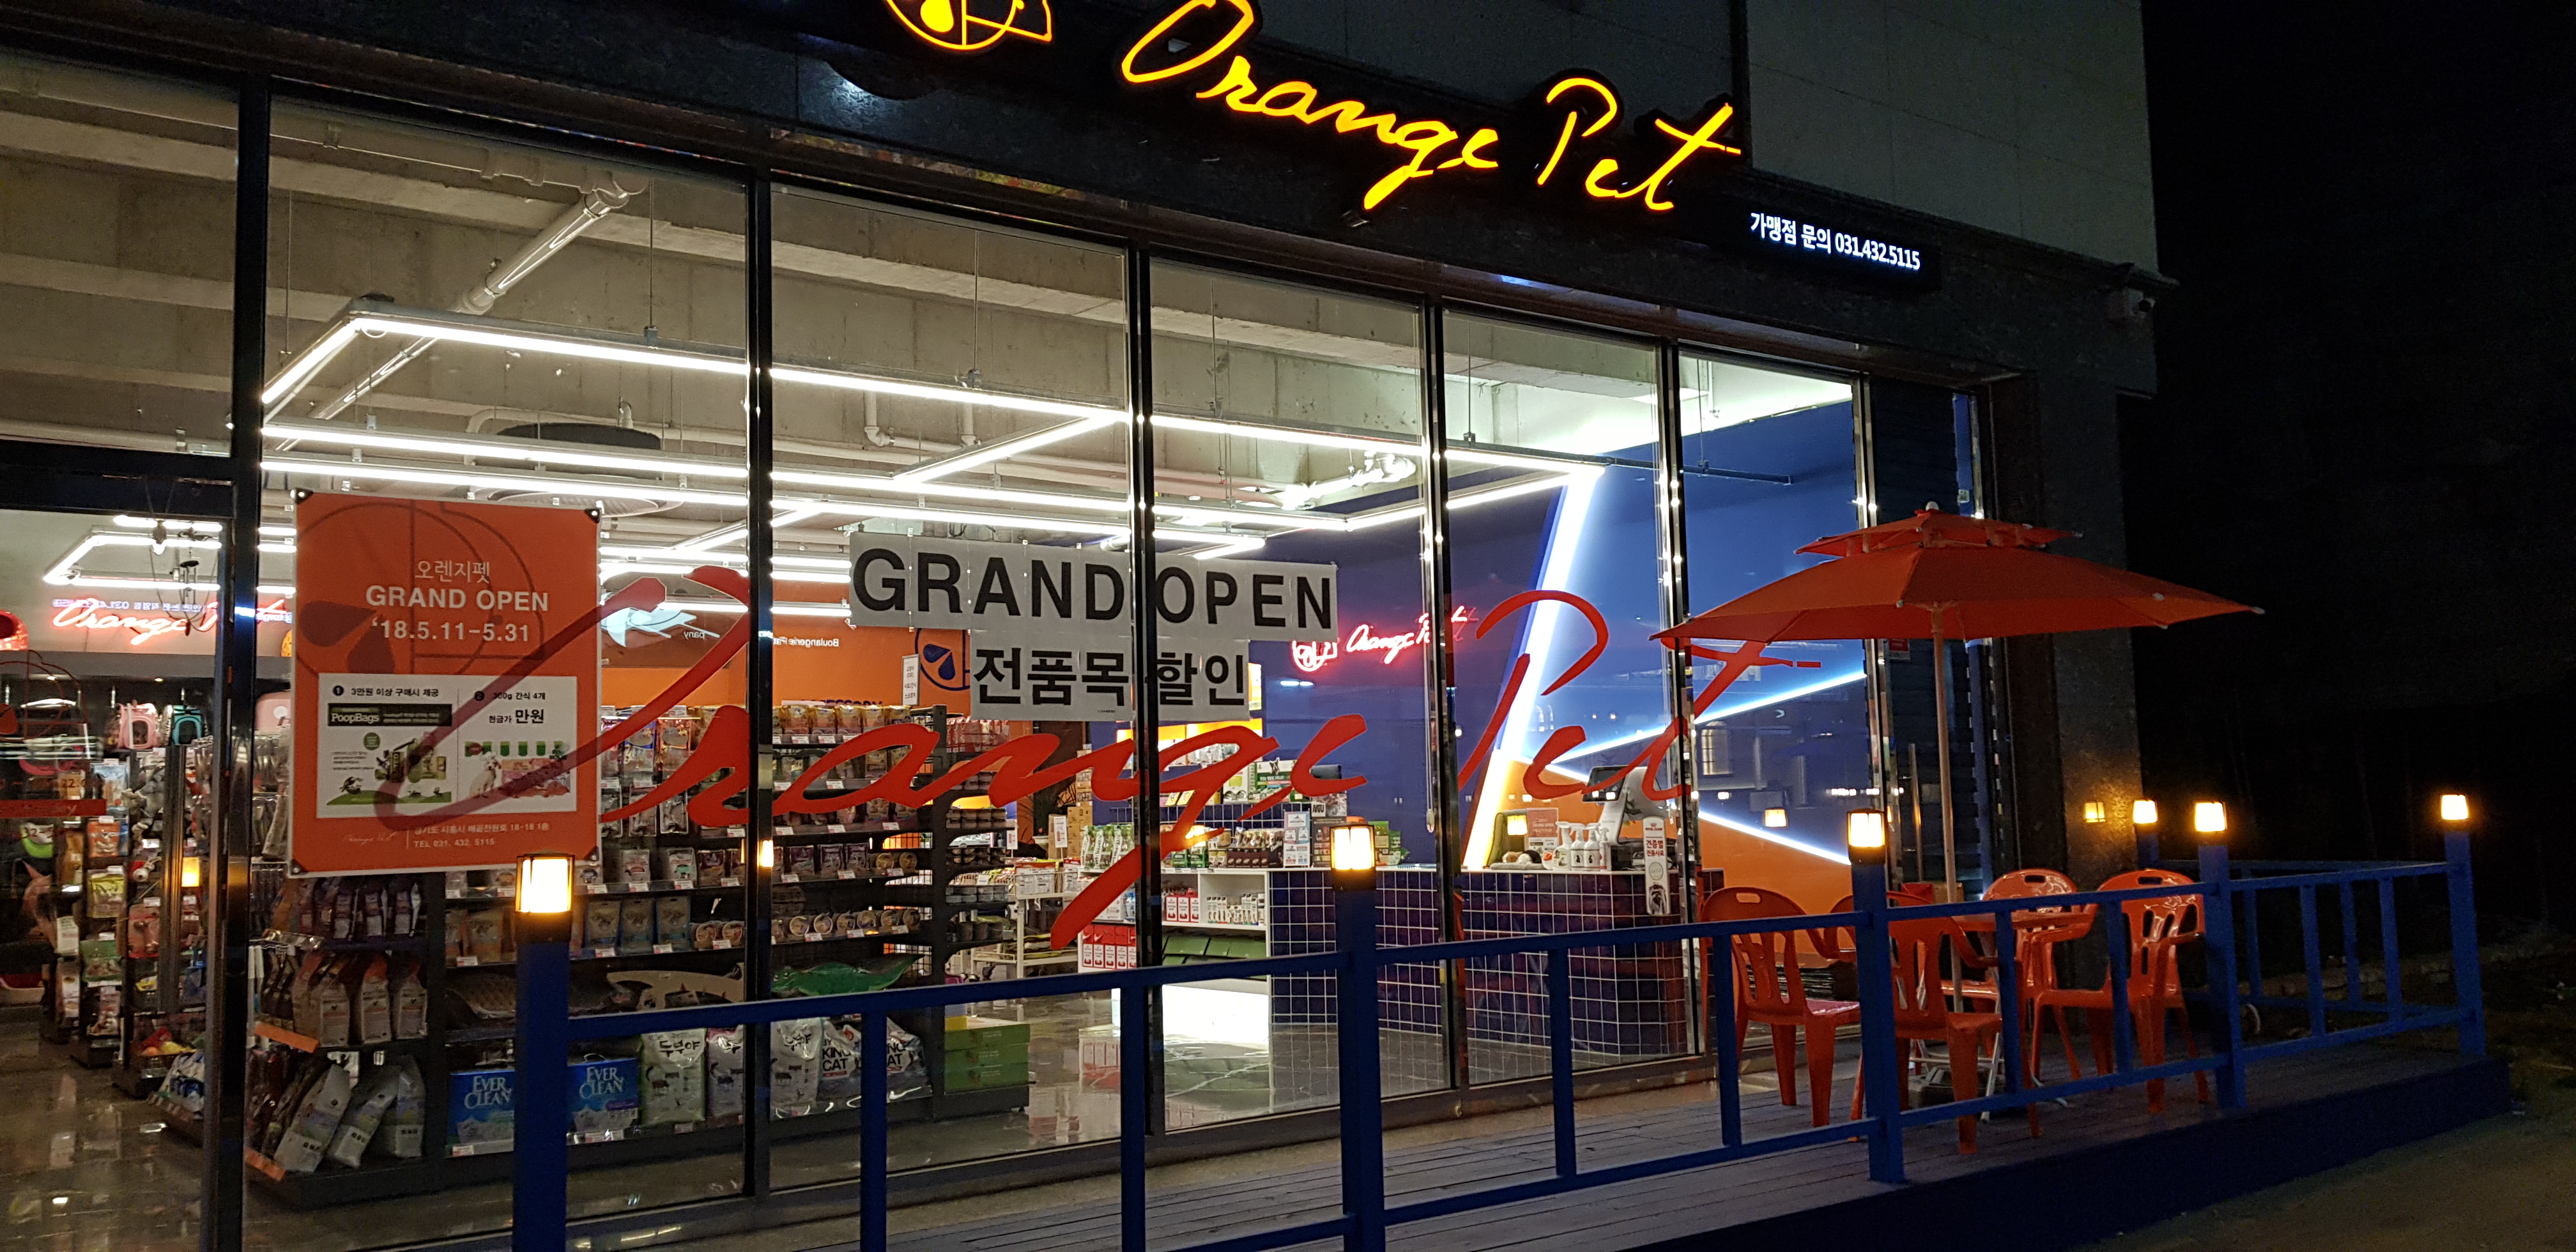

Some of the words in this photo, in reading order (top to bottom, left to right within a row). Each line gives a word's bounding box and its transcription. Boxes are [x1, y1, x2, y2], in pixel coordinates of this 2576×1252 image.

[1121, 0, 1499, 210] Orange
[1537, 77, 1741, 211] Pet
[1751, 211, 1797, 247] 가맹점
[1801, 223, 1832, 254] 문의
[1834, 232, 1921, 271] 031.432.5115
[415, 560, 491, 584] 오렌지펫
[365, 584, 466, 609] GRAND
[476, 589, 549, 612] OPEN
[852, 548, 1125, 621] GRAND
[1156, 566, 1331, 630] OPEN
[972, 646, 1130, 707] 전품목
[1156, 650, 1244, 707] 할인
[351, 687, 374, 697] 3만원
[376, 687, 393, 697] 이상
[422, 687, 440, 697] 제공
[515, 692, 531, 701] 간식
[533, 692, 546, 701] 4개
[330, 712, 379, 724] PoopBags
[489, 715, 512, 724] 현금가
[515, 708, 544, 724] 만원
[413, 839, 431, 848] TEL
[659, 1039, 701, 1058] 두부야
[586, 1066, 624, 1082] EVER
[822, 1058, 848, 1072] CAT
[473, 1076, 511, 1092] EVER
[579, 1077, 624, 1099] CLEAN
[464, 1088, 512, 1110] CLEAN
